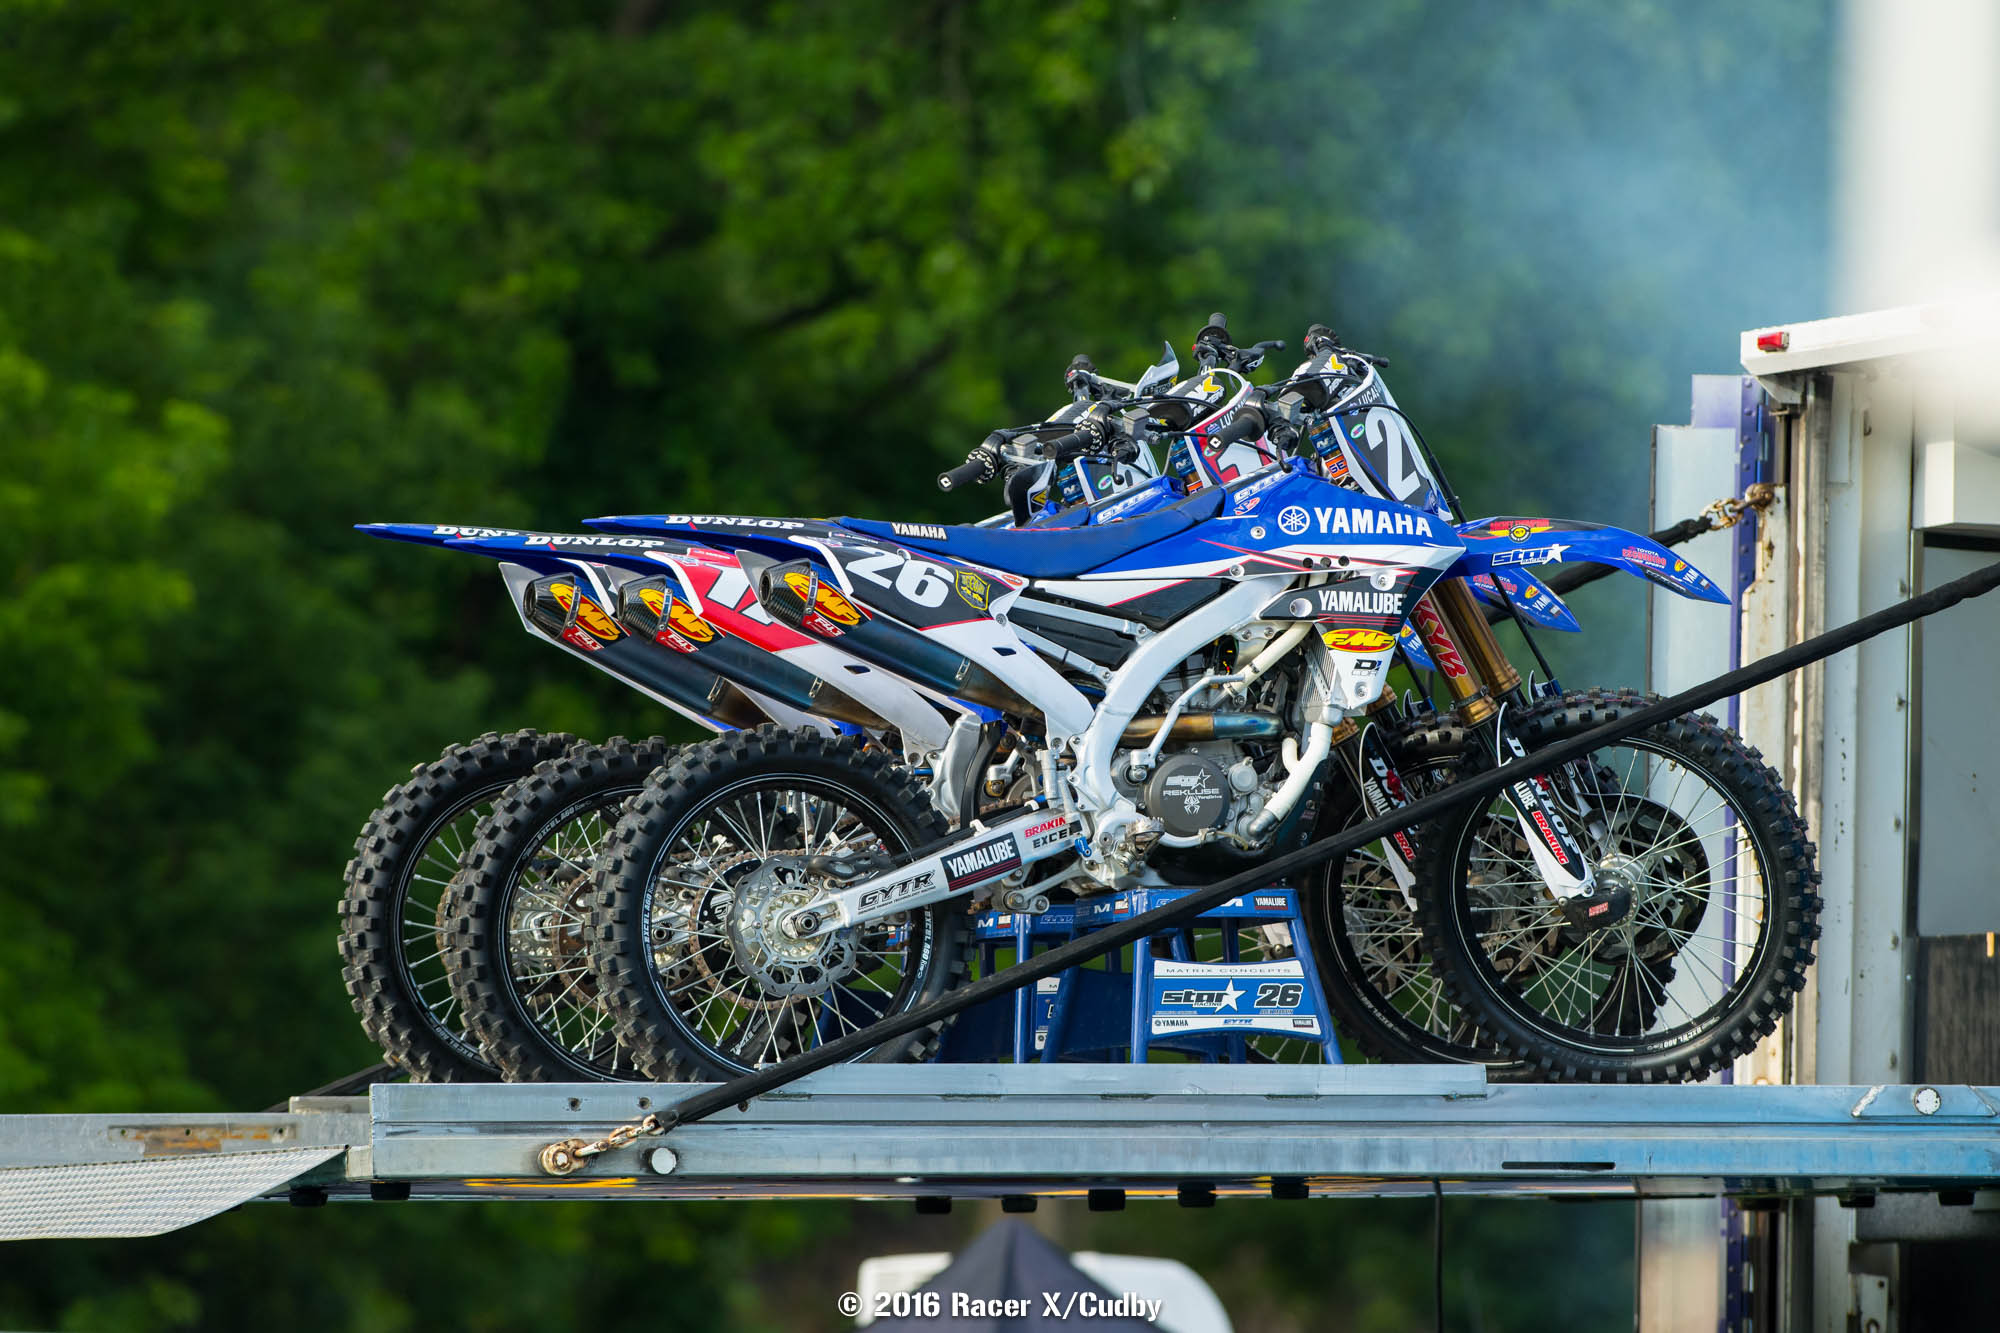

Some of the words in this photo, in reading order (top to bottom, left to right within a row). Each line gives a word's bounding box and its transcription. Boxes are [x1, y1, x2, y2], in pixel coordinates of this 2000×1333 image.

[665, 515, 805, 531] DUNLOP
[892, 522, 948, 541] YAMAHA
[1314, 507, 1433, 538] YAMAHA
[524, 535, 665, 549] DUNLOP
[846, 547, 954, 608] 26
[1318, 590, 1402, 614] YAMALUBE
[1322, 630, 1396, 648] FMF
[1163, 788, 1219, 796] REKLUSE
[1531, 810, 1569, 864] BRAKING
[946, 840, 1016, 879] YAMALUBE
[857, 870, 936, 911] GYTR
[1255, 897, 1286, 907] YAMALUBE
[643, 911, 651, 943] EXCEL
[924, 911, 932, 941] EXCEL
[922, 942, 931, 960] A60
[1253, 983, 1304, 1008] 26
[1161, 1019, 1189, 1027] YAMAHA
[1678, 1025, 1702, 1043] EXCEL
